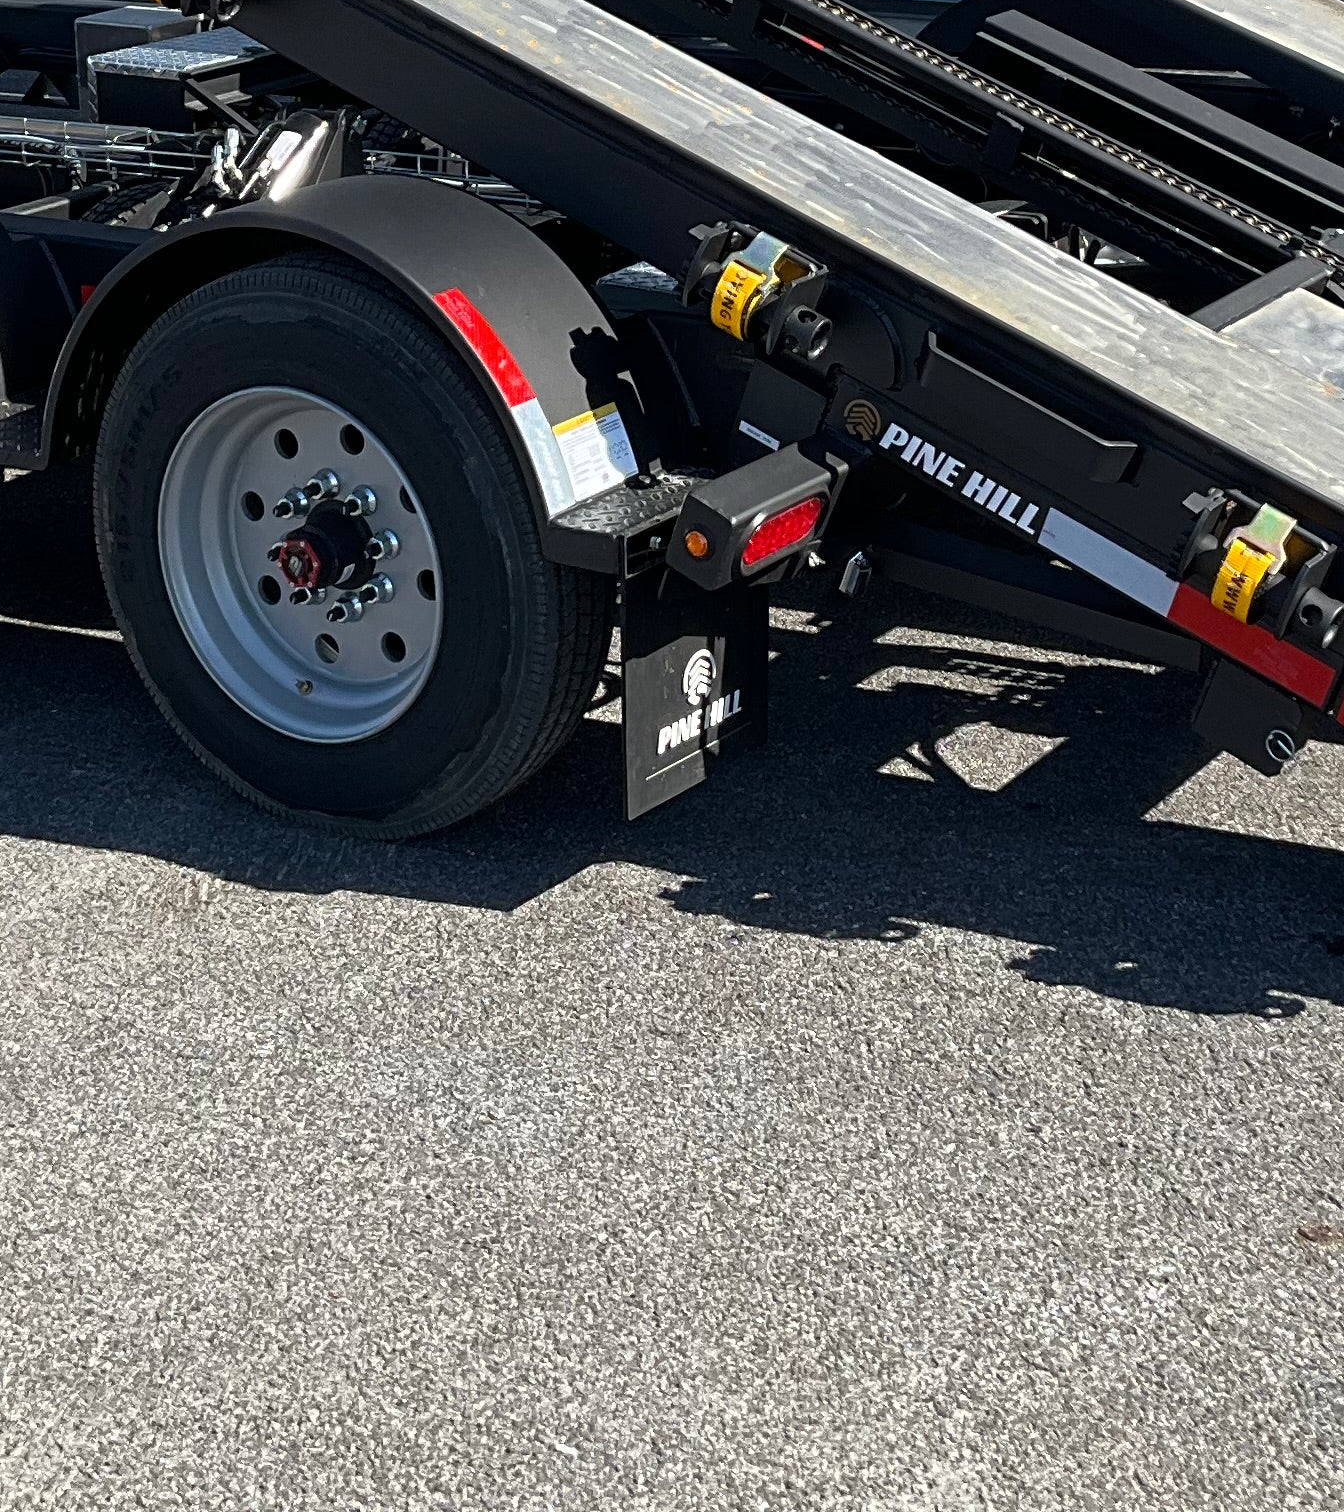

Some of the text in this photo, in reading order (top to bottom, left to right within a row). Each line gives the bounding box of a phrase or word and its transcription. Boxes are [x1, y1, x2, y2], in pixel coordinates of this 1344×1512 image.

[878, 422, 1040, 535] PINE HILL
[657, 688, 743, 755] PINE HILL
